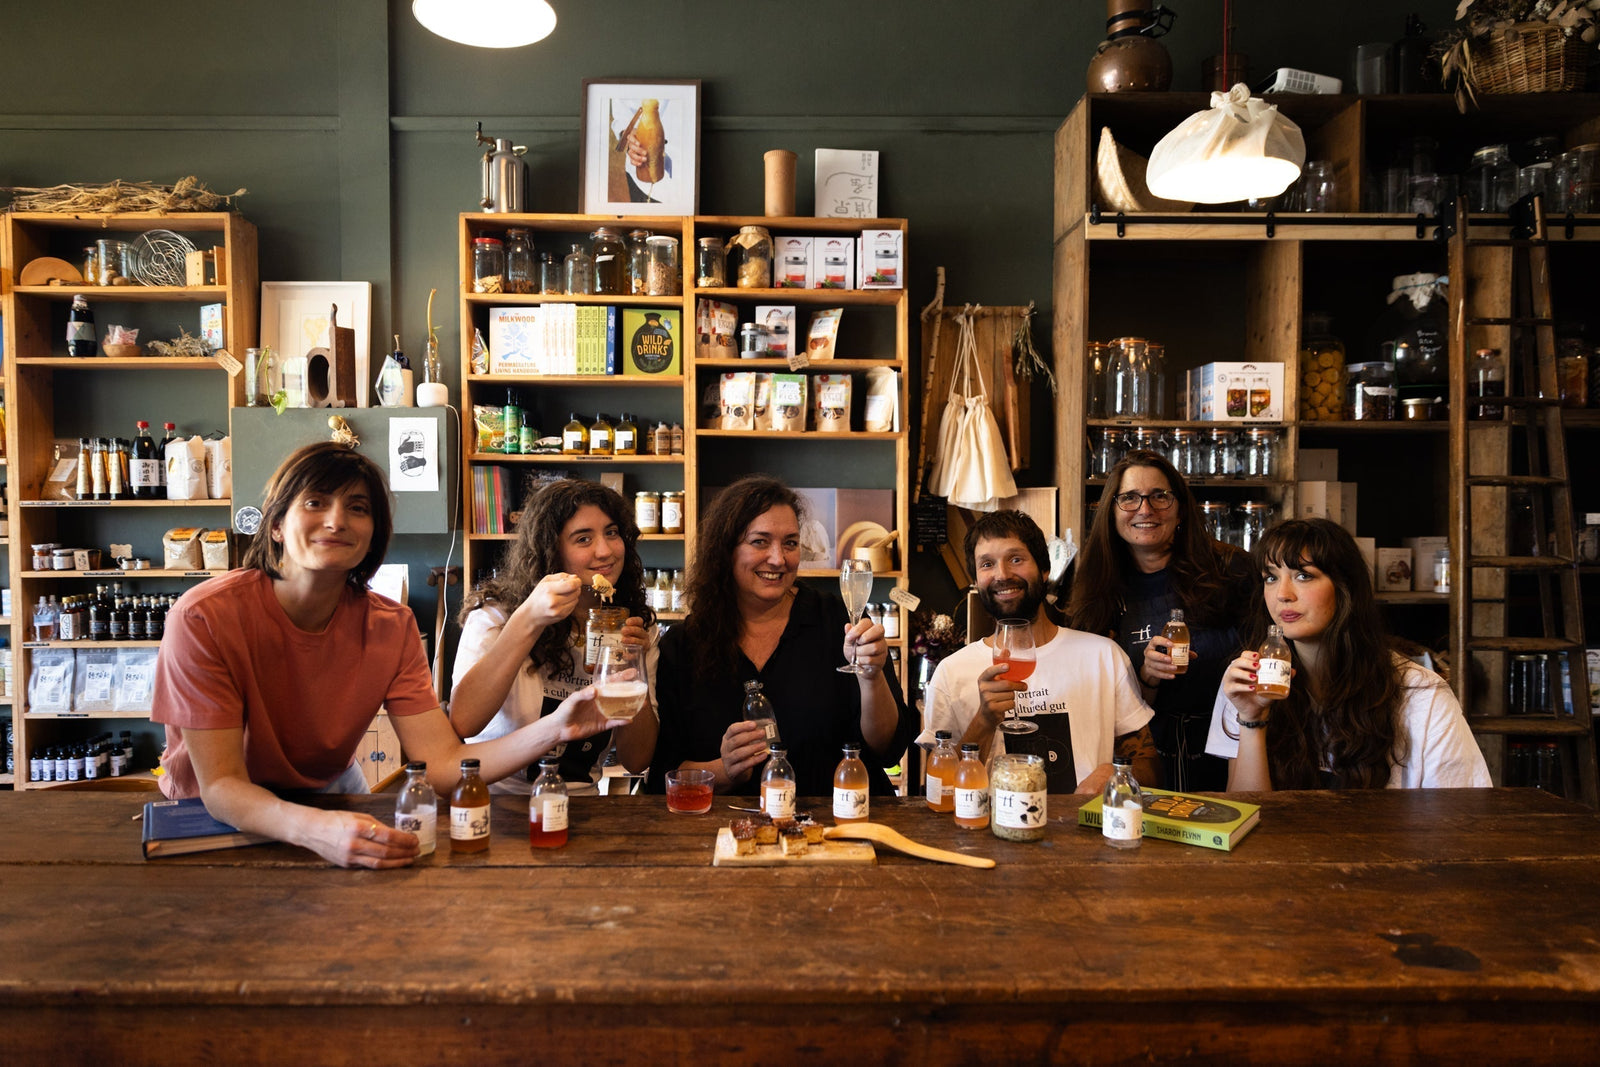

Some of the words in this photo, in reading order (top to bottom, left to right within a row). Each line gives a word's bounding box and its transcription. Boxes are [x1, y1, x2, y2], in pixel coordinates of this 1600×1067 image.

[498, 315, 535, 323] MILKWOOD
[641, 334, 663, 345] WILD
[636, 344, 669, 356] DRINKS
[558, 672, 594, 686] Portrai
[1018, 688, 1049, 699] ortrait
[1049, 702, 1067, 714] gut
[1156, 826, 1181, 838] SHARON
[1182, 830, 1202, 841] FLYNN
